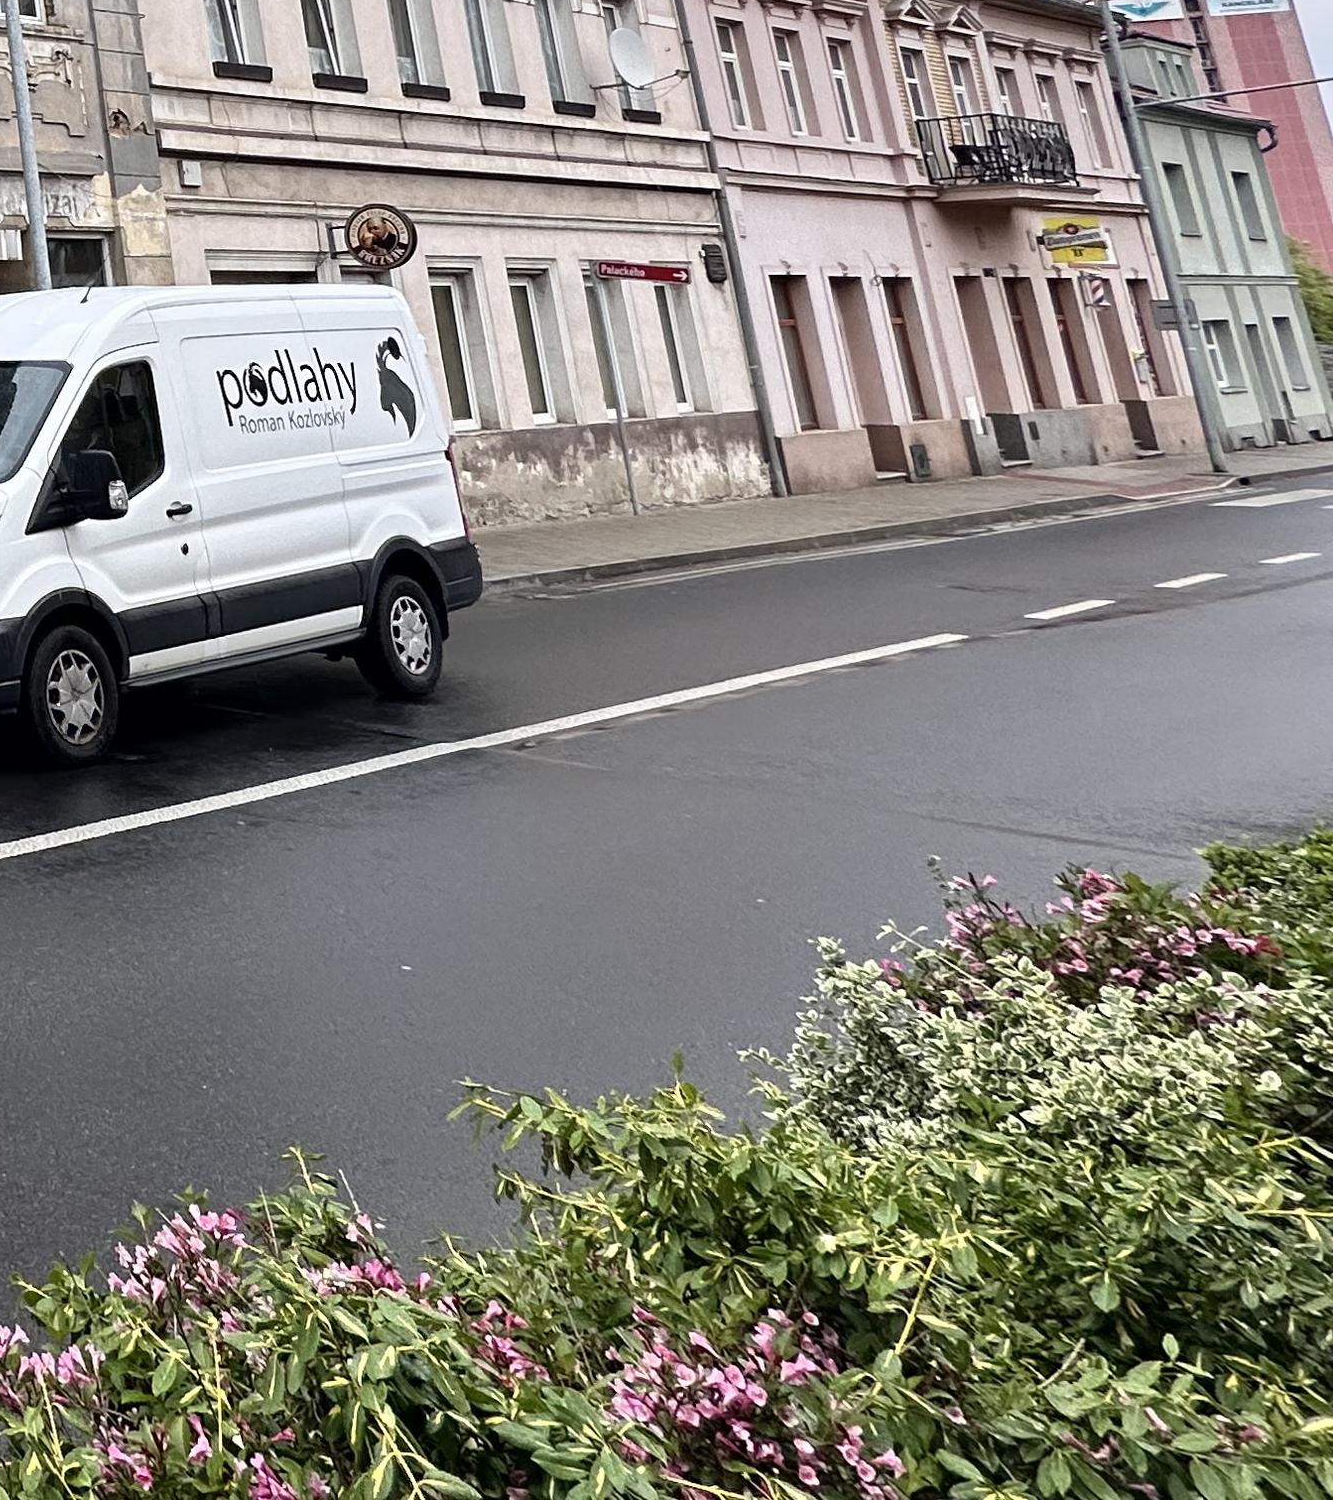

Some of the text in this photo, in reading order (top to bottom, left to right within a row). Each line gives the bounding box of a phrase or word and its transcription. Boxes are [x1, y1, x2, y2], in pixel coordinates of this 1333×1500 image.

[600, 264, 646, 278] Palackého
[216, 347, 357, 427] podlahy
[239, 404, 346, 435] Roman Kozlovský
